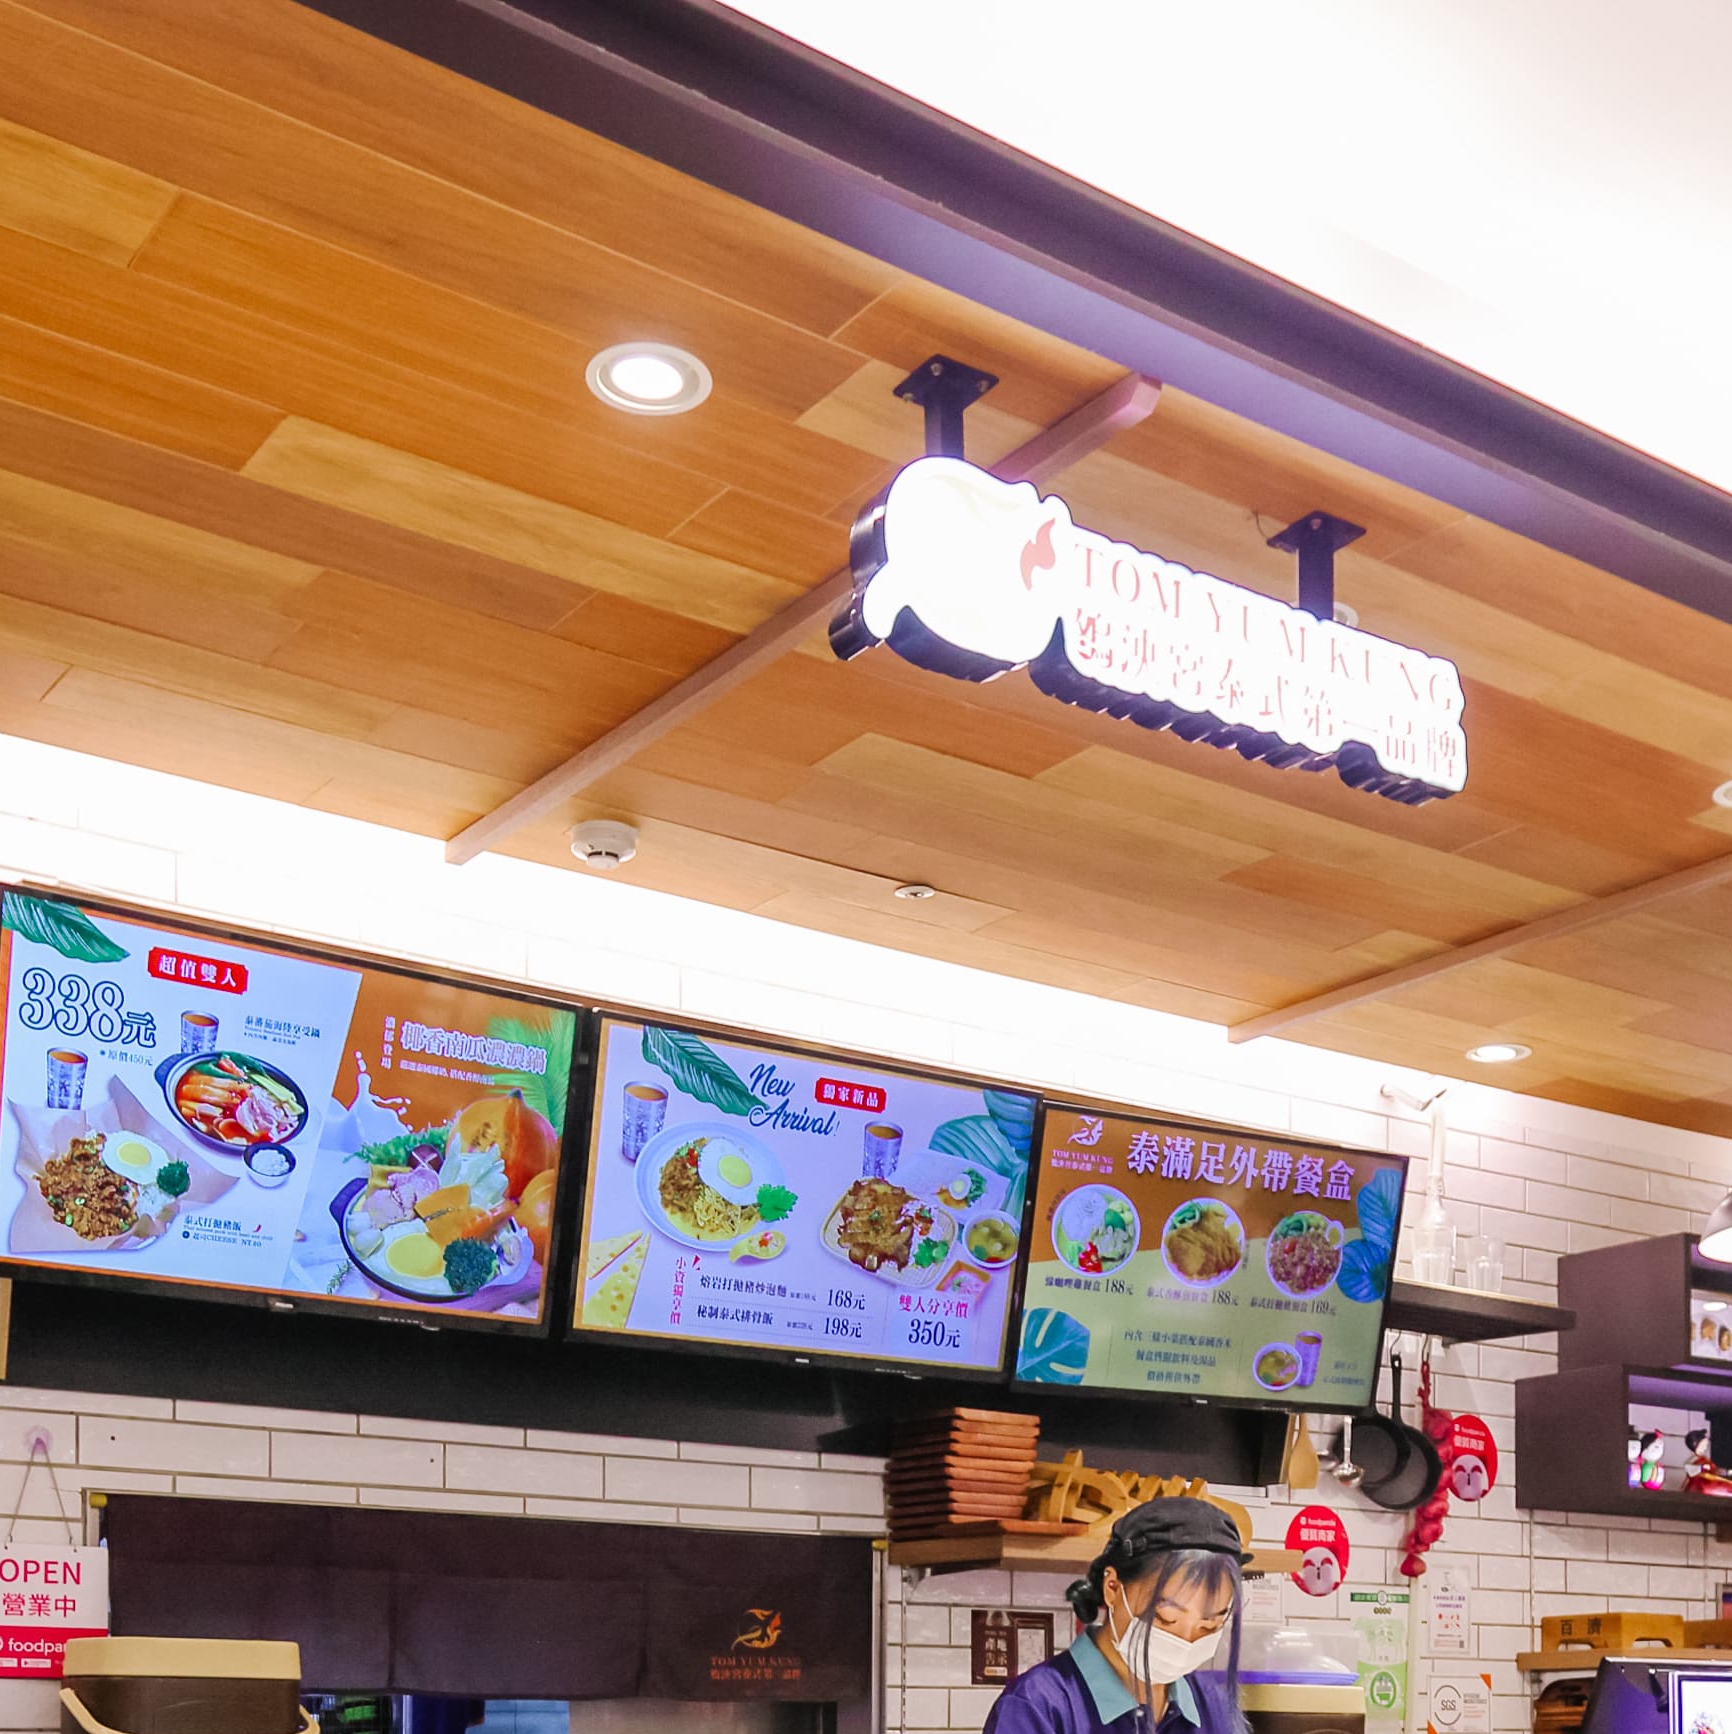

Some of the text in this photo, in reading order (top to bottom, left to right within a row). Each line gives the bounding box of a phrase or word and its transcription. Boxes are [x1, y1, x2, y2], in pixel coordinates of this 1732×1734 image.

[1073, 542, 1455, 712] TOM YUM KUNG
[158, 954, 237, 988] 超值雙人
[19, 967, 156, 1048] 338元
[401, 1021, 547, 1074] 椰香南瓜濃濃鍋
[749, 1064, 795, 1097] New
[823, 1082, 879, 1108] 獨家新品
[748, 1099, 841, 1137] Arrival!
[1127, 1130, 1356, 1202] 泰滿足外帶餐盒
[670, 1256, 686, 1325] 小資獨享價
[827, 1288, 866, 1311] 168元
[899, 1294, 969, 1319] 雙人分享價
[823, 1317, 862, 1339] 198元
[908, 1318, 961, 1348] 350元
[2, 1592, 77, 1618] 營業中
[8, 1636, 67, 1656] foodpa
[710, 1656, 801, 1666] TOM YUM KUNG
[1441, 1699, 1457, 1711] SGS
